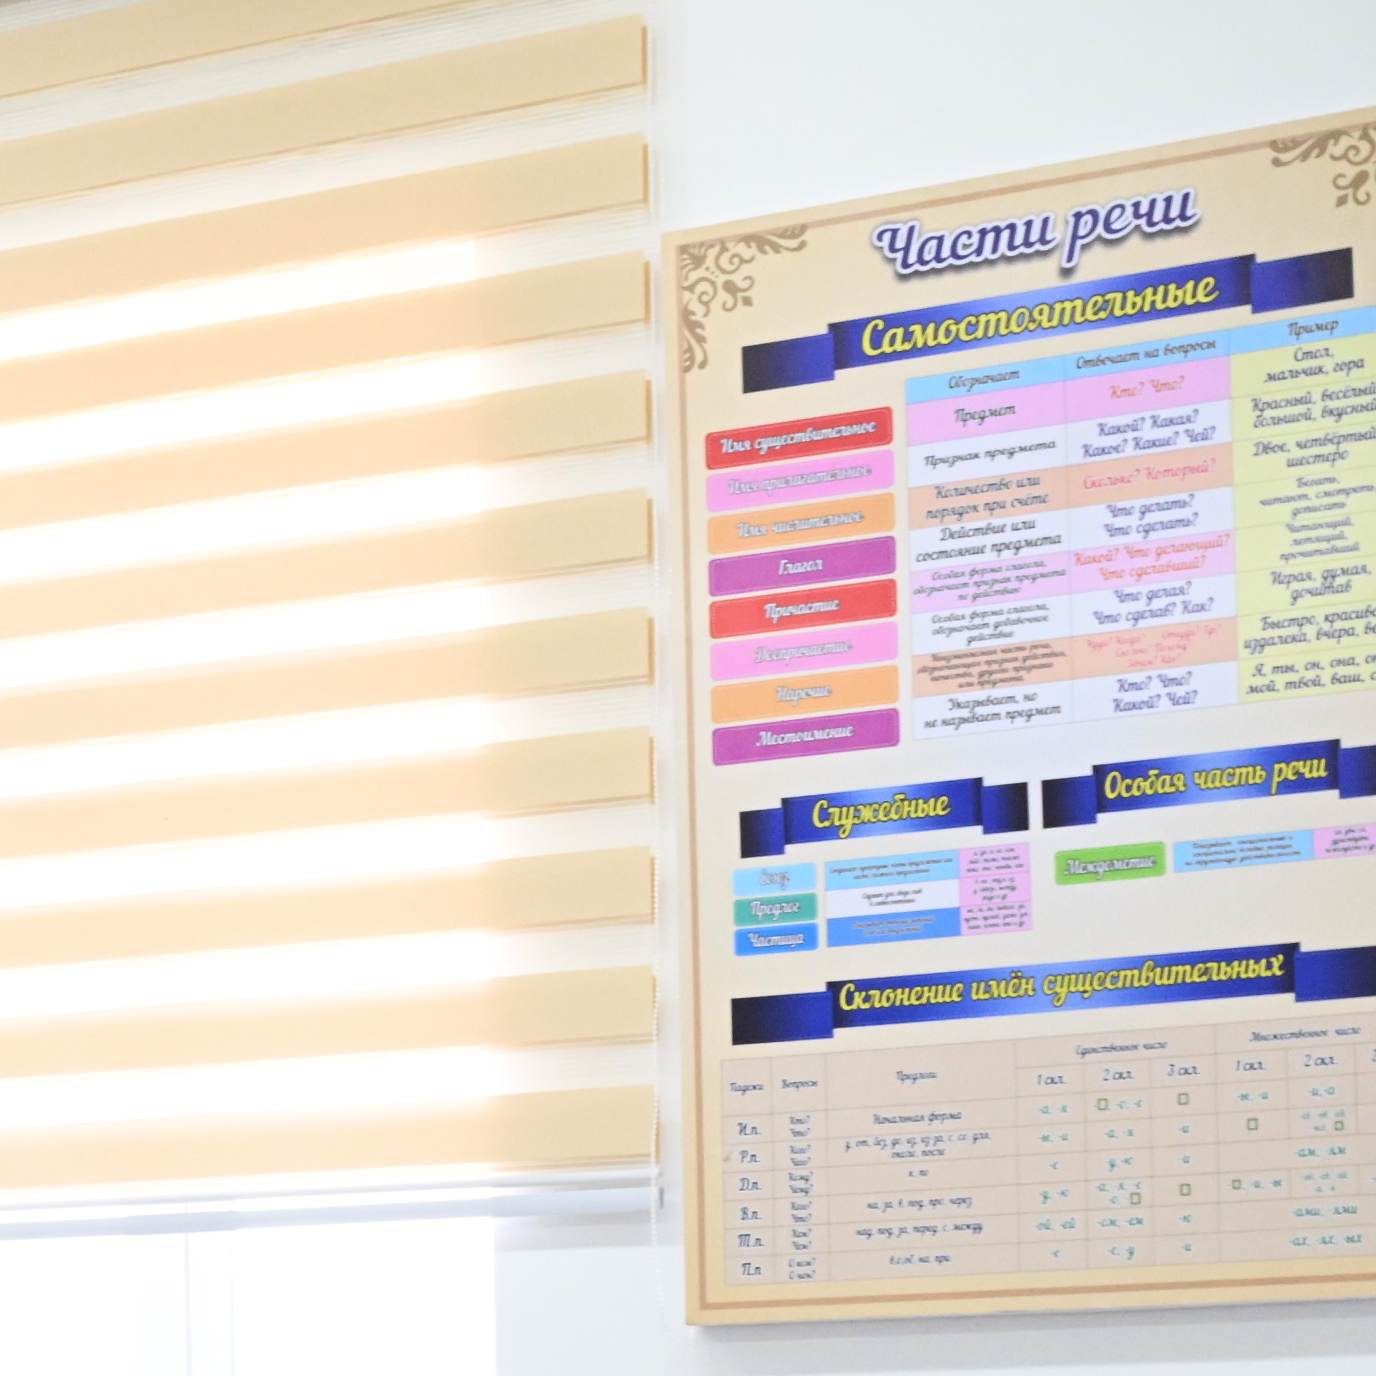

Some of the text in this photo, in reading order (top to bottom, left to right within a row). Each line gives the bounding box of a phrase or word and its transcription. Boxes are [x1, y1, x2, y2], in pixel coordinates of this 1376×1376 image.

[877, 190, 1195, 271] Части речи
[862, 275, 1217, 356] Самостоятельные
[1288, 320, 1339, 340] Пример
[1076, 351, 1139, 369] Отвечает
[1164, 339, 1216, 359] вопросы
[1333, 358, 1364, 376] гора
[948, 369, 1020, 392] Обозначает
[1110, 376, 1185, 399] Кто? Что?
[955, 404, 1015, 427] Предмет
[1098, 409, 1199, 437] Какой? Какая?
[721, 421, 877, 455] Имя существительное
[1133, 432, 1179, 451] Какие?
[924, 441, 1056, 468] Признак предмета
[728, 464, 871, 496] Имя прилагательное
[934, 476, 1041, 500] Количество или
[926, 502, 980, 525] порядок
[983, 498, 1007, 516] при
[1106, 494, 1194, 518] Что делать?
[736, 509, 864, 538] Имя числительное
[940, 519, 1036, 541] Действие или
[1104, 513, 1198, 539] Что сделать?
[916, 533, 1062, 562] состояние предмета
[779, 558, 824, 575] Глагол
[1098, 564, 1126, 580] Что
[1113, 586, 1142, 603] Что
[765, 598, 840, 624] Причастие
[1092, 609, 1121, 625] Что
[776, 683, 833, 706] Наречие
[756, 724, 854, 748] Местоимение
[1105, 755, 1329, 800] Особая часть речи
[812, 794, 951, 838] Служебные
[760, 870, 790, 890] Союз
[1064, 856, 1157, 880] Междометие
[750, 900, 800, 922] Предлог
[748, 932, 804, 946] Частица
[839, 953, 1286, 1013] Склонение имён существительных
[1304, 1055, 1311, 1067] 2
[1103, 1069, 1110, 1081] 2
